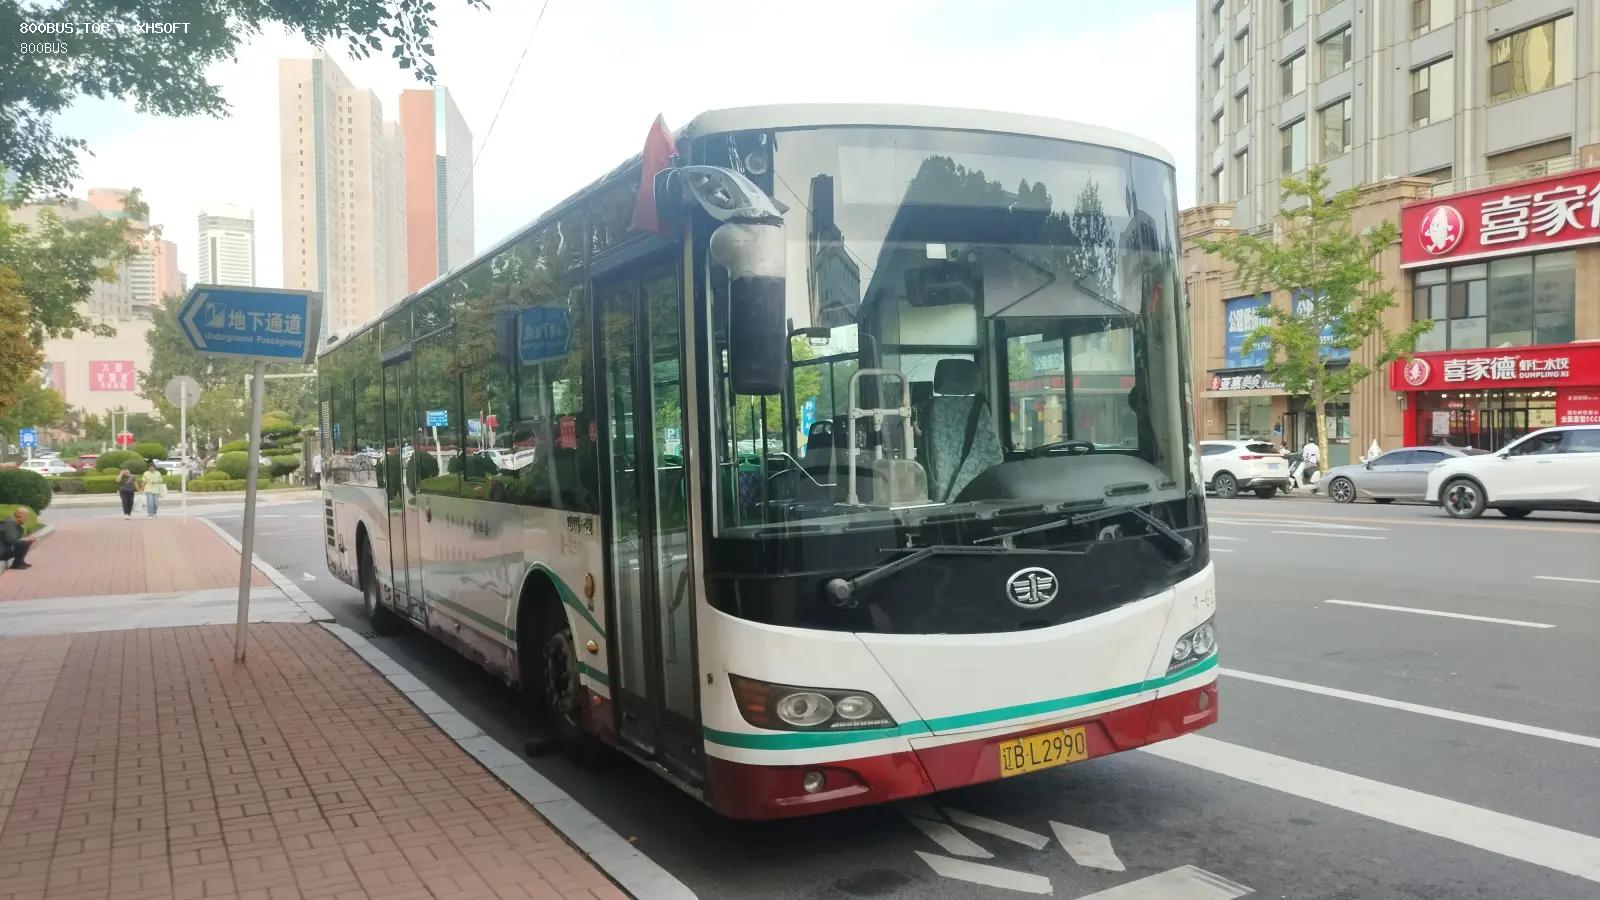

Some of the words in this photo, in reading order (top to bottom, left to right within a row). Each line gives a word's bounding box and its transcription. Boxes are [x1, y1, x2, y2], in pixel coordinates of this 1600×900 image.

[227, 308, 303, 335] 地下通道
[204, 331, 254, 343] Underground
[255, 335, 303, 348] Passageway
[1443, 355, 1517, 382] 喜家德
[1518, 357, 1570, 372] 虾仁水饺
[1518, 371, 1559, 379] DUMPLING
[1560, 370, 1570, 378] XI
